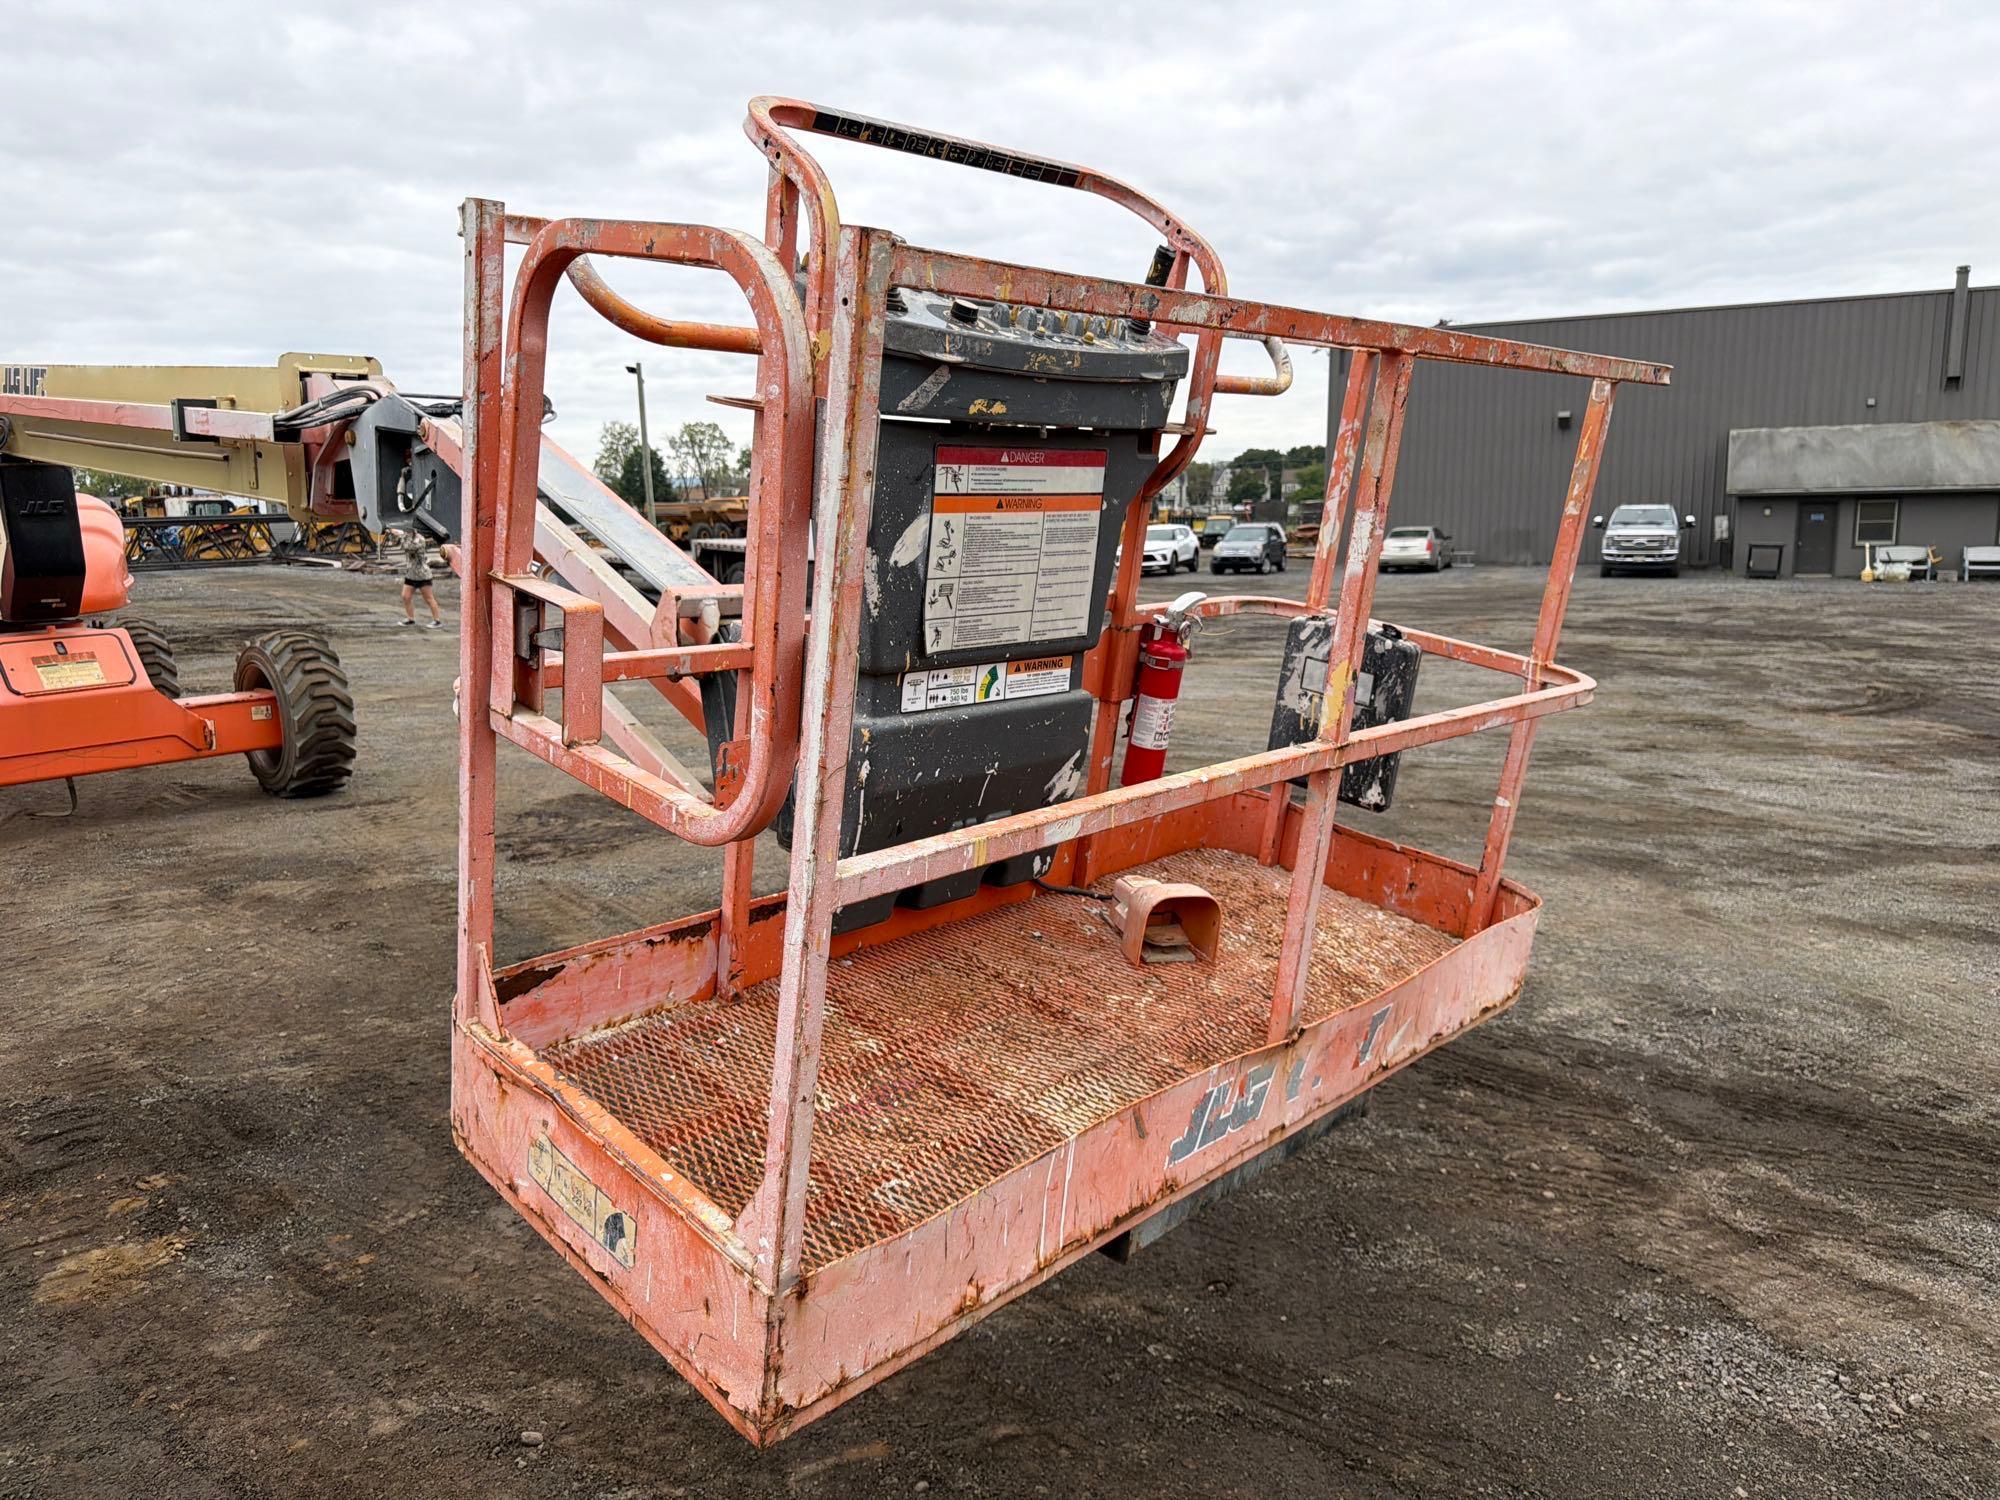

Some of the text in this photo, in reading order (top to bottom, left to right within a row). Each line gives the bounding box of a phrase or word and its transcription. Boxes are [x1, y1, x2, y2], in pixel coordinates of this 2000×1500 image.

[3, 367, 20, 394] JLG
[1010, 451, 1044, 463] DANGER
[19, 499, 65, 515] JLG
[1005, 498, 1042, 509] WARNING
[1024, 659, 1063, 671] WARNING
[961, 694, 968, 702] kg
